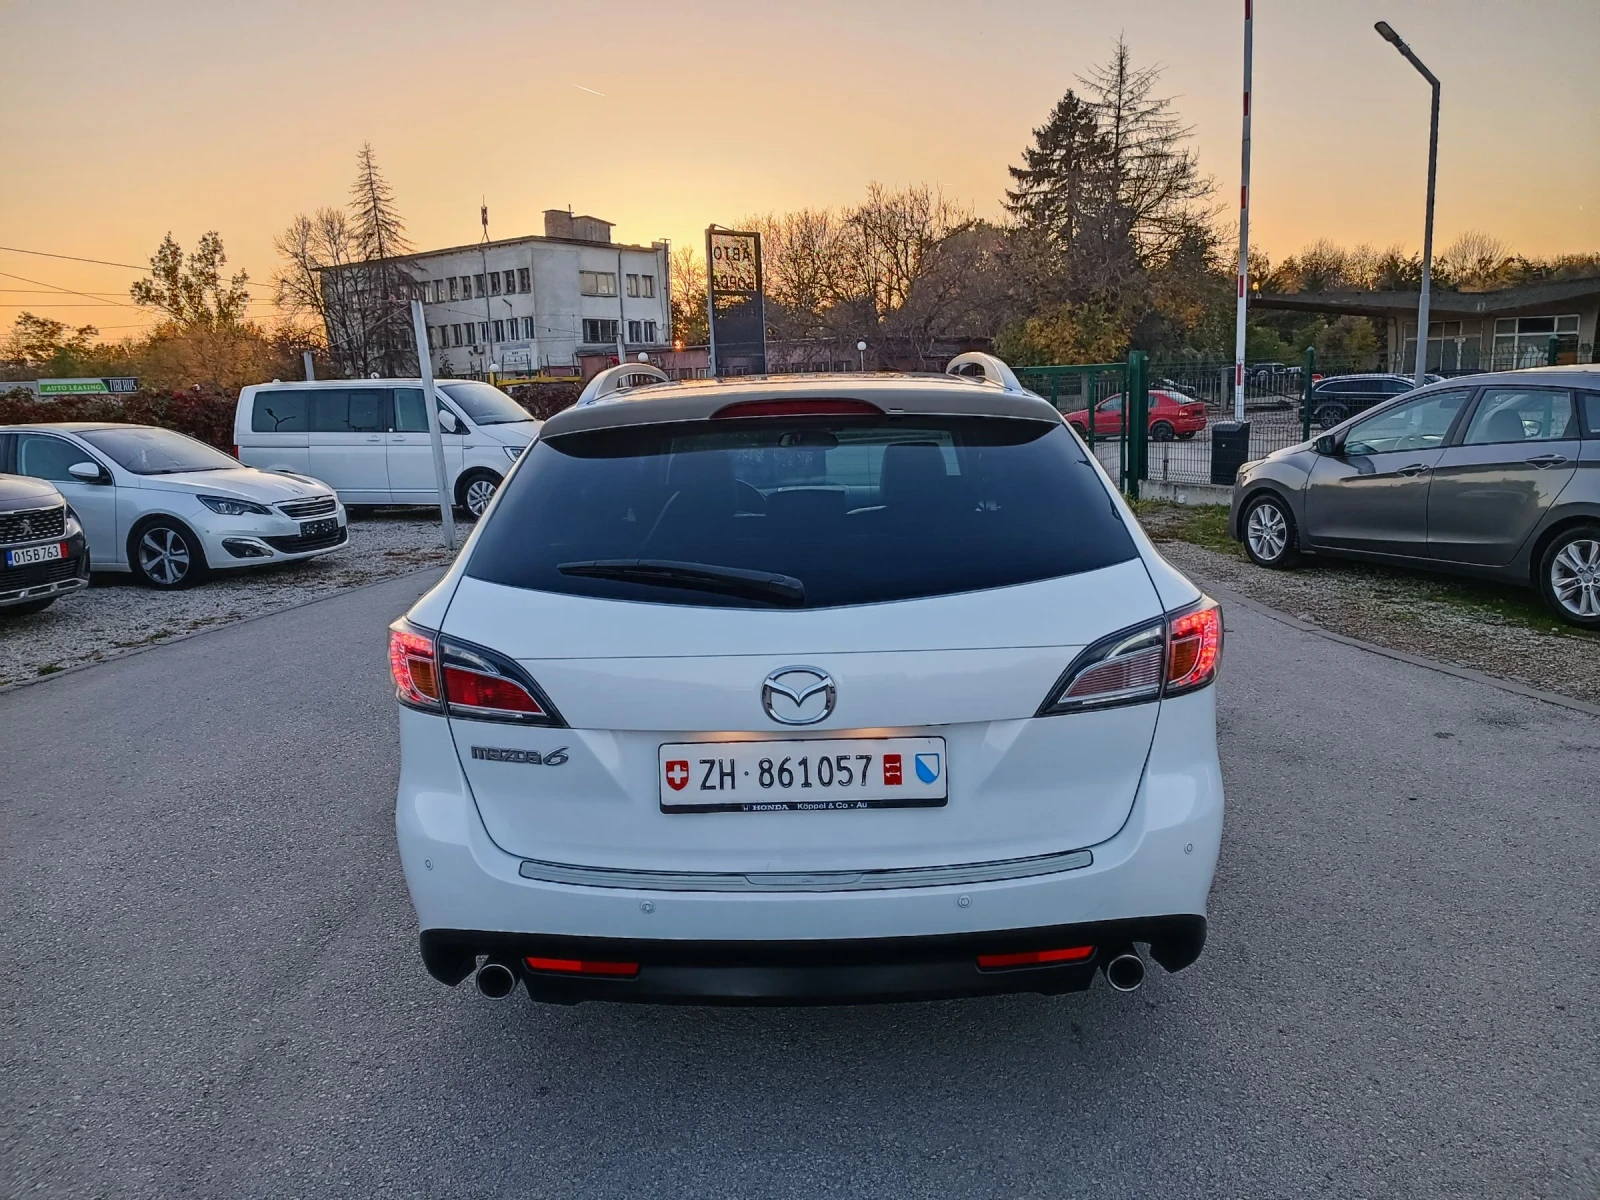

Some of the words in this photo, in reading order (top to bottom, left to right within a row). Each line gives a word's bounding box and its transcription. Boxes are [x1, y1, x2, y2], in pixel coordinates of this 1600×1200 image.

[699, 758, 736, 791] ZH
[758, 754, 873, 789] 861057
[752, 803, 789, 811] HONDA
[797, 802, 827, 811] Köppel
[836, 801, 848, 809] Co
